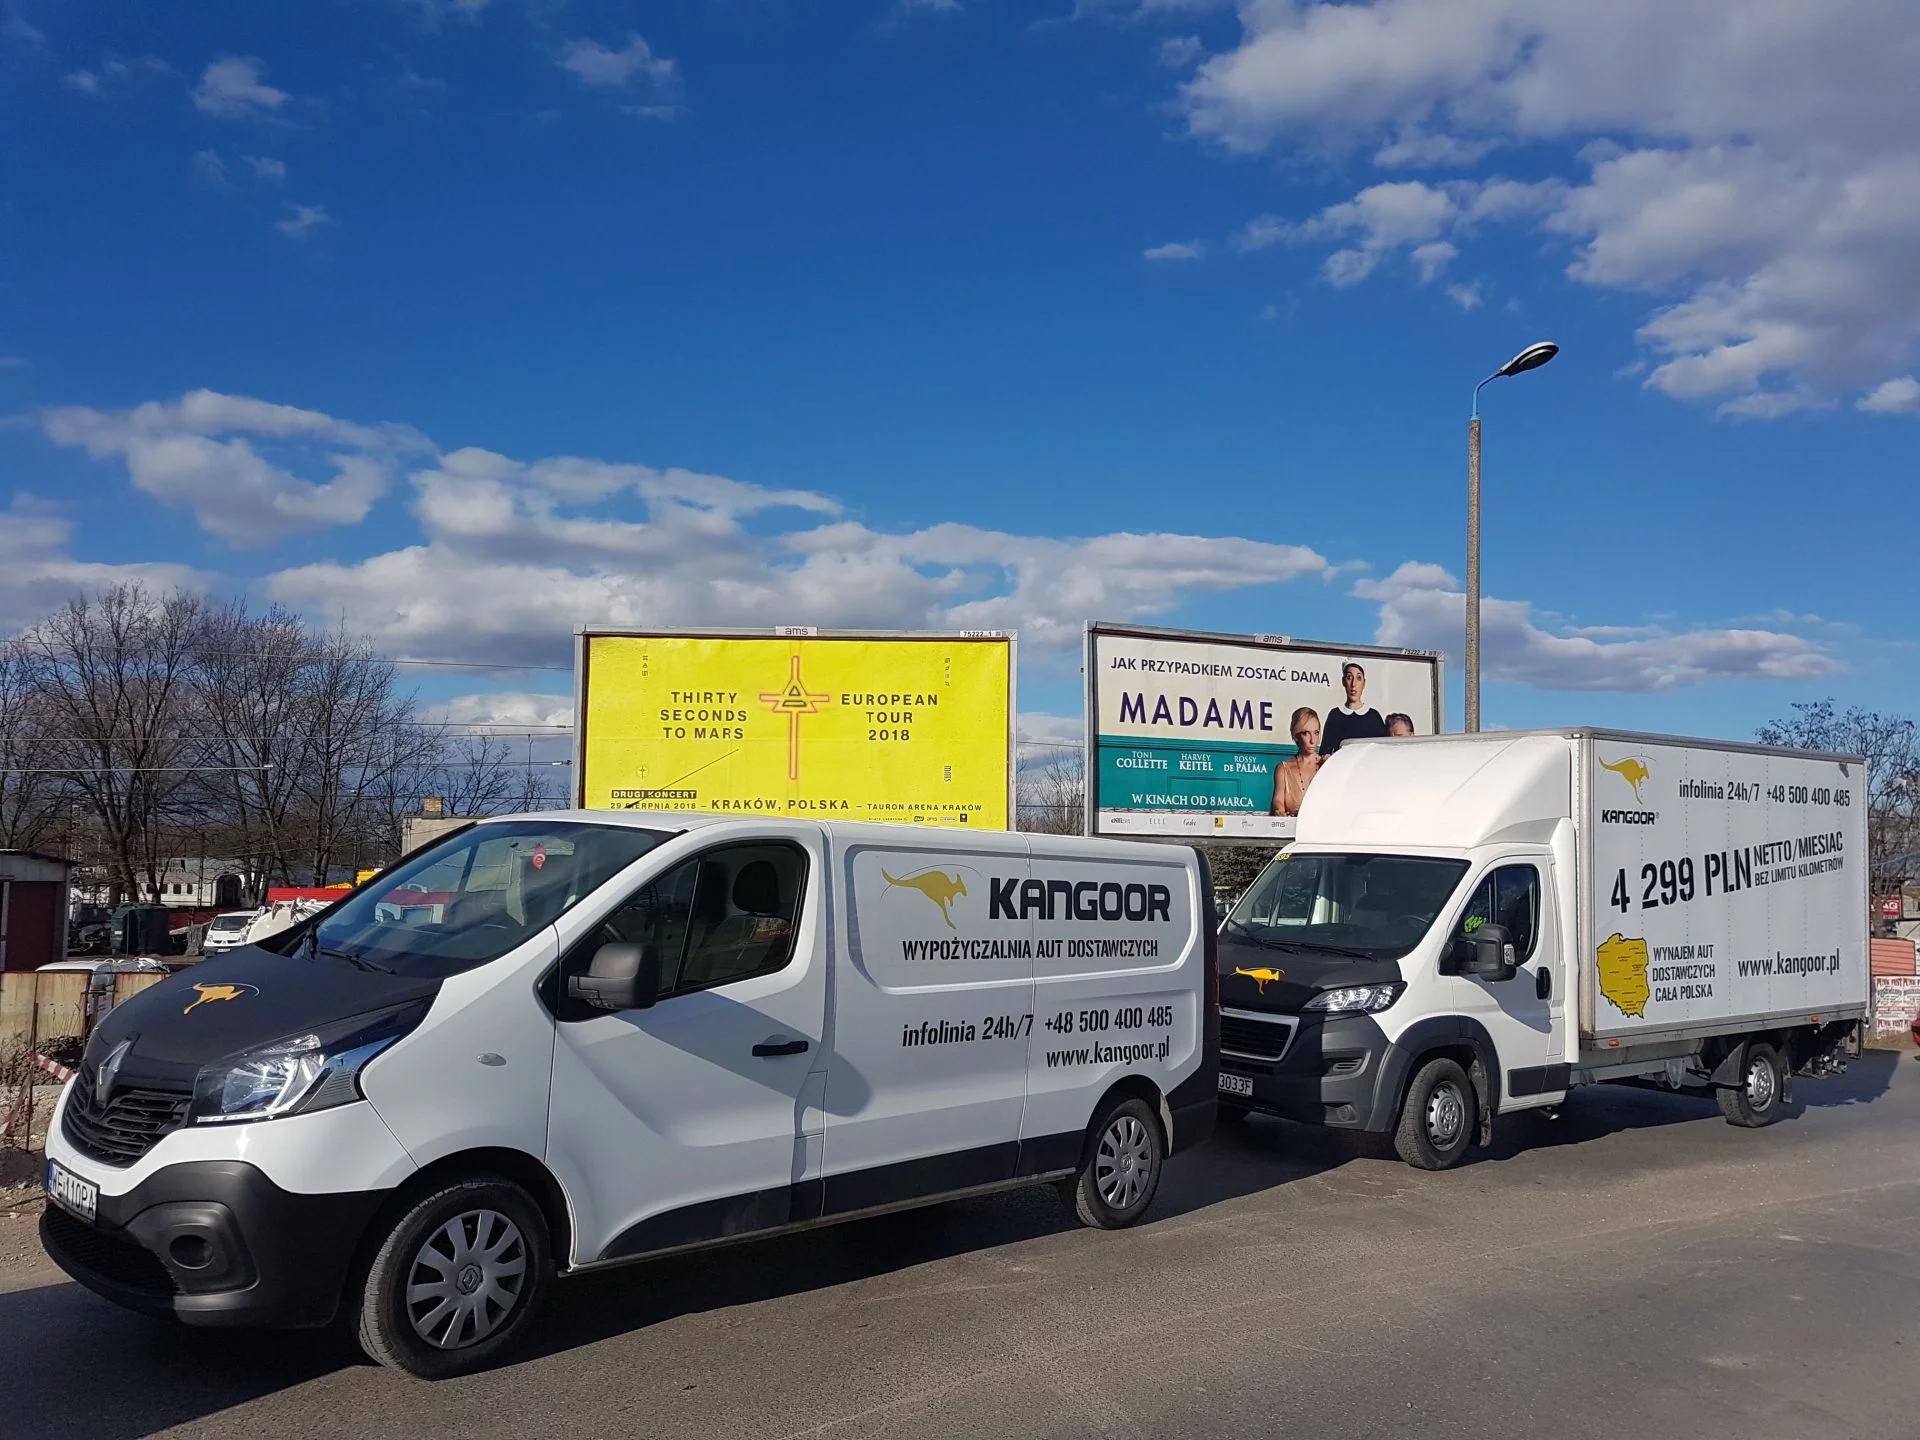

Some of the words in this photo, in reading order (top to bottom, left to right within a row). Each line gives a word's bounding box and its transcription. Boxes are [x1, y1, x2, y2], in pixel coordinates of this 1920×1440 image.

[785, 627, 808, 636] ams
[1263, 635, 1283, 644] ams
[1111, 657, 1136, 670] JAK
[1141, 659, 1232, 677] PRZYPADKIEM
[1236, 666, 1287, 681] ZOSTAĆ
[1291, 671, 1330, 687] DAMĄ
[671, 691, 737, 704] THIRTY
[841, 693, 938, 706] EUROPEAN
[660, 709, 747, 722] SECONDS
[866, 711, 913, 723] TOUR
[1119, 691, 1273, 731] MADAME
[663, 727, 686, 739] TO
[694, 727, 744, 740] MARS
[868, 729, 910, 741] 2018
[1132, 751, 1152, 759] TONI
[1181, 753, 1211, 762] HARVEY
[1234, 755, 1257, 764] ROSSY
[1116, 758, 1168, 770] COLLETTE
[1179, 760, 1213, 771] KEITEL
[1223, 764, 1234, 772] DE
[1236, 763, 1268, 774] PALMA
[649, 791, 696, 799] KONCERT
[1679, 779, 1724, 800] infolinia
[1727, 781, 1760, 803] 24h/7
[1766, 785, 1785, 803] +48
[1788, 785, 1808, 804] 500
[1811, 787, 1831, 806] 400
[1833, 789, 1850, 807] 485
[674, 802, 696, 810] 2018
[711, 798, 781, 811] KRAKÓW,
[788, 800, 849, 810] POLSKA
[942, 803, 982, 811] KRAKÓW
[1132, 794, 1143, 804] W
[1146, 795, 1188, 806] KINACH
[1190, 796, 1208, 806] OD
[1210, 797, 1216, 807] 8
[1218, 797, 1254, 807] MARCA
[1601, 809, 1655, 826] KANGOOR
[1754, 870, 1769, 887] BEZ
[1771, 865, 1797, 884] LIMITU
[1798, 855, 1844, 878] KILOMETRÓW
[1611, 868, 1631, 914] 4
[1640, 857, 1695, 910] 299
[1704, 847, 1752, 897] PLN
[989, 877, 1171, 922] KANGOOR
[902, 936, 1032, 961] WYPOŻYCZALNIA
[1036, 939, 1064, 958] AUT
[1067, 939, 1159, 958] DOSTAWCZYCH
[1653, 945, 1695, 962] WYNAJEM
[1697, 944, 1714, 959] AUT
[1737, 947, 1840, 978] www.kangoor.pl
[1652, 963, 1716, 982] DOSTAWCZYCH
[1655, 986, 1678, 1002] CAŁA
[1680, 983, 1713, 1000] POLSKA
[1044, 1011, 1074, 1035] +48
[1079, 1009, 1109, 1033] 500
[1114, 1007, 1143, 1030] 400
[1147, 1005, 1173, 1027] 485
[902, 1018, 976, 1047] infolinia
[981, 1014, 1034, 1040] 24h/7
[1046, 1035, 1171, 1068] www.kangoor.pl
[1220, 1074, 1251, 1093] 3033F
